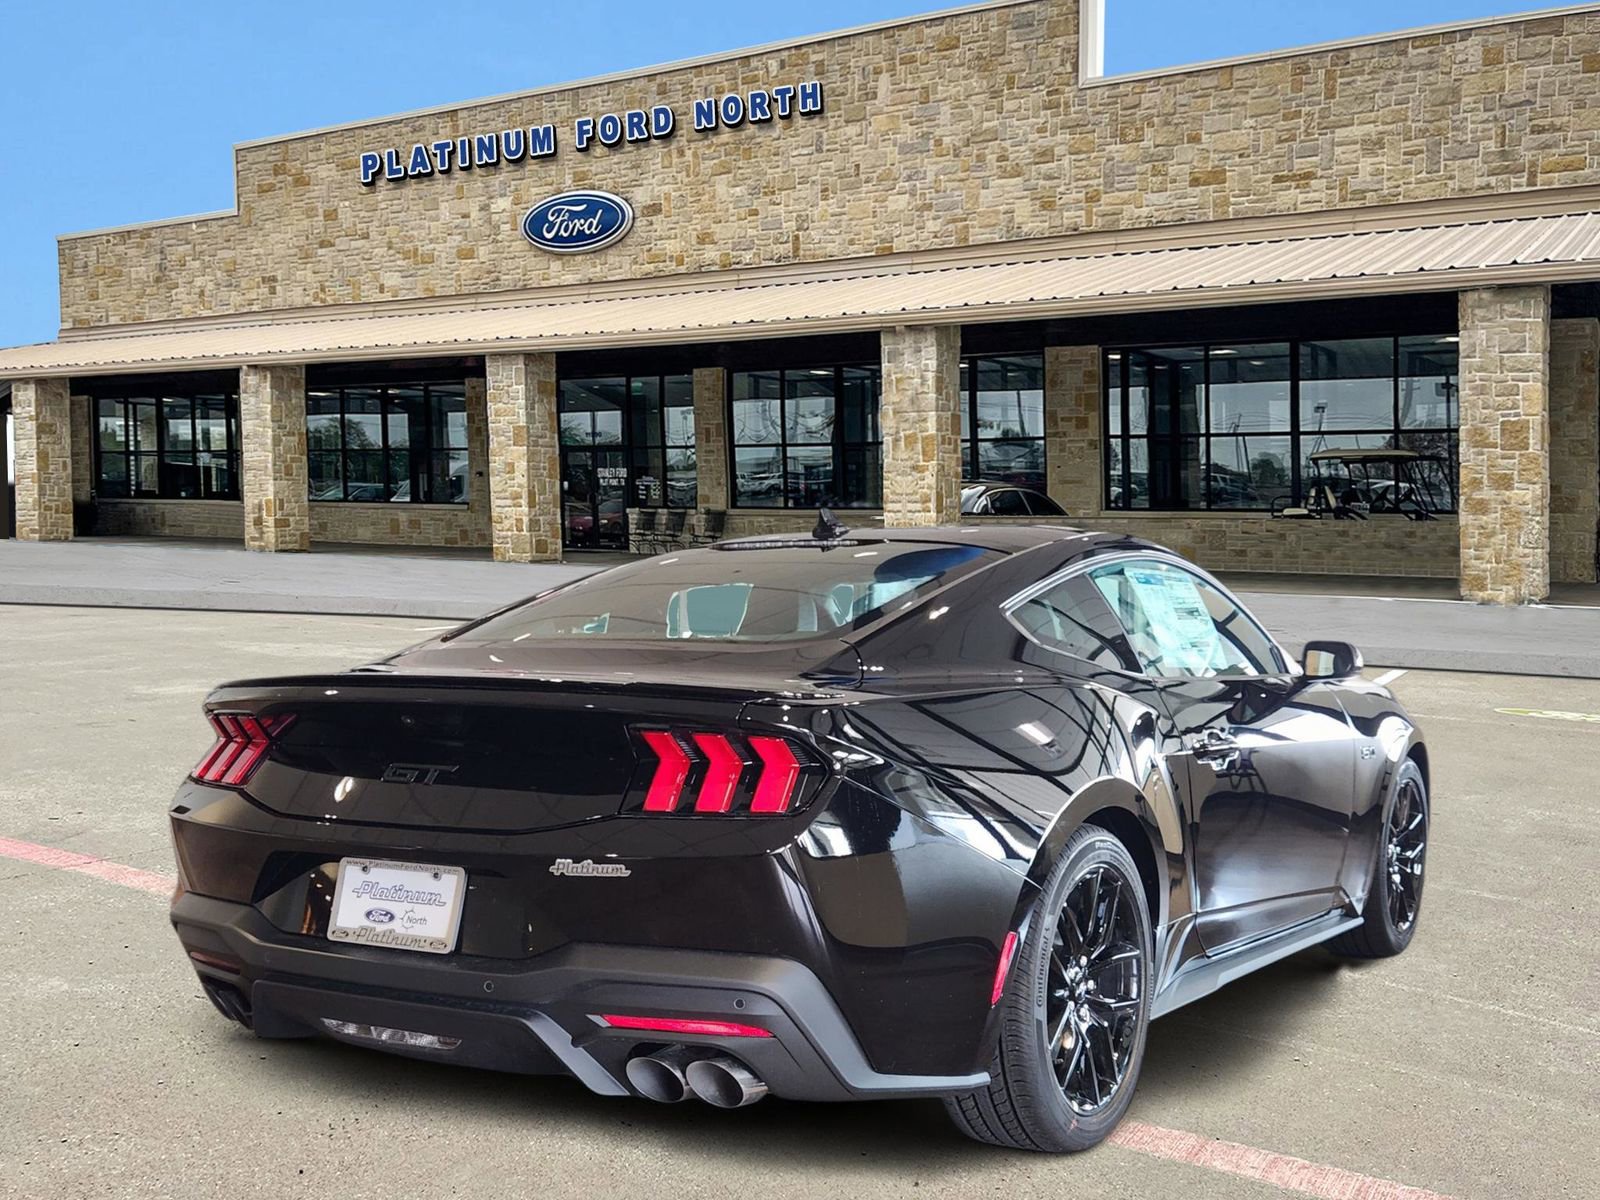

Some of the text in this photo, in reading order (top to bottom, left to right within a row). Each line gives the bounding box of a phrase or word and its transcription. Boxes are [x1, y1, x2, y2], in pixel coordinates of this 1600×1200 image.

[360, 81, 823, 185] PLATINUM FORD NORTH
[541, 203, 603, 240] Ford
[381, 763, 460, 785] GT
[549, 858, 632, 877] Platinum
[352, 881, 446, 906] Platinum
[368, 909, 392, 924] Ford
[406, 916, 428, 927] North
[356, 927, 426, 948] Platinum
[1036, 935, 1049, 1007] Continental
